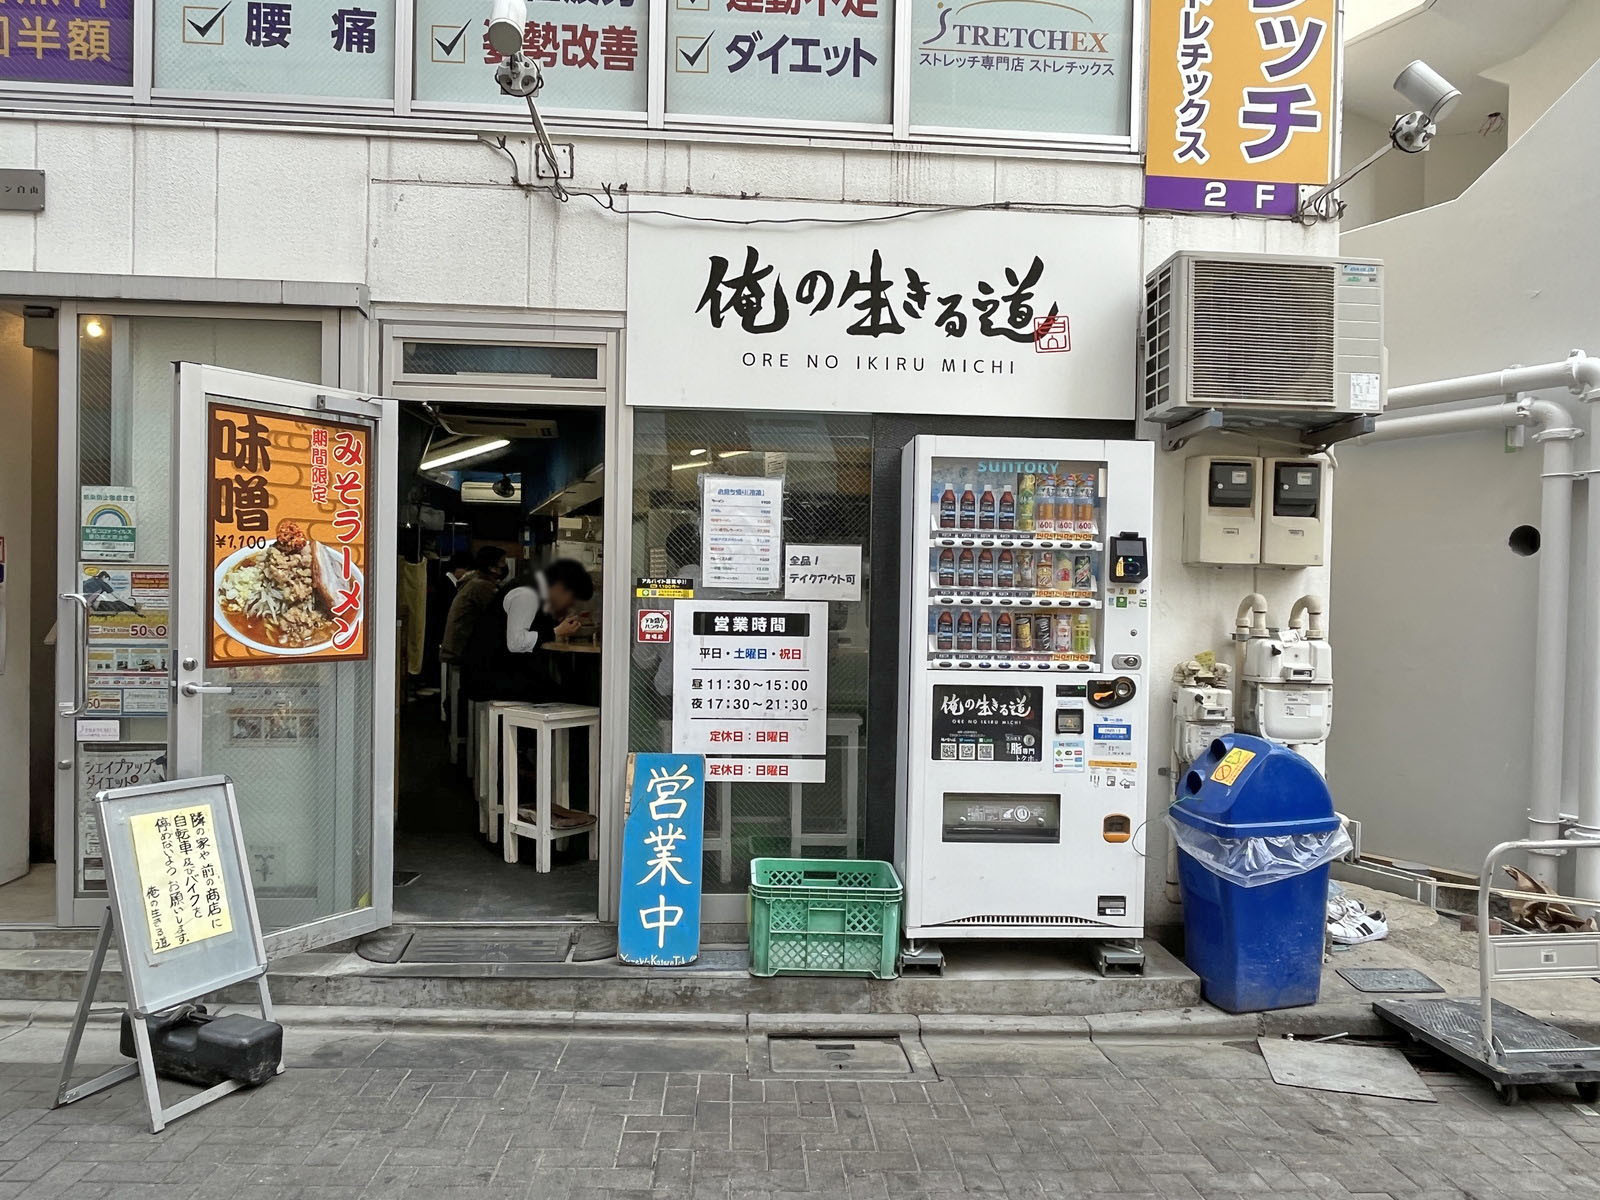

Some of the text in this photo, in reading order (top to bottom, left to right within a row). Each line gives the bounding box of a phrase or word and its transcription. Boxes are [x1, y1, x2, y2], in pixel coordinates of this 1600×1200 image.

[245, 2, 376, 54] 腰 痛
[922, 8, 1109, 53] STRETCHEX
[725, 30, 878, 78] ダイエット
[919, 53, 1115, 76] ストレッチ専門店 ストレチックス
[1243, 0, 1324, 159] ッチ
[695, 245, 1062, 343] 俺の生きる道
[742, 353, 1015, 375] ORE NO IKIRU MICHI
[214, 415, 271, 532] 味噌
[311, 429, 328, 504] 期間限定
[215, 533, 266, 550] ¥1,100
[332, 432, 364, 651] みそラーメン
[789, 573, 856, 585] テイクアウト可
[713, 616, 787, 633] 営業時間
[699, 648, 802, 660] 平日・土曜日・祝日
[691, 679, 703, 690] 昼
[691, 698, 703, 710] 夜
[940, 693, 1032, 718] 俺の生きる道
[173, 814, 203, 919] 自転車及びバイクを
[635, 764, 695, 949] 営業中
[146, 885, 171, 950] 俺の生きる道
